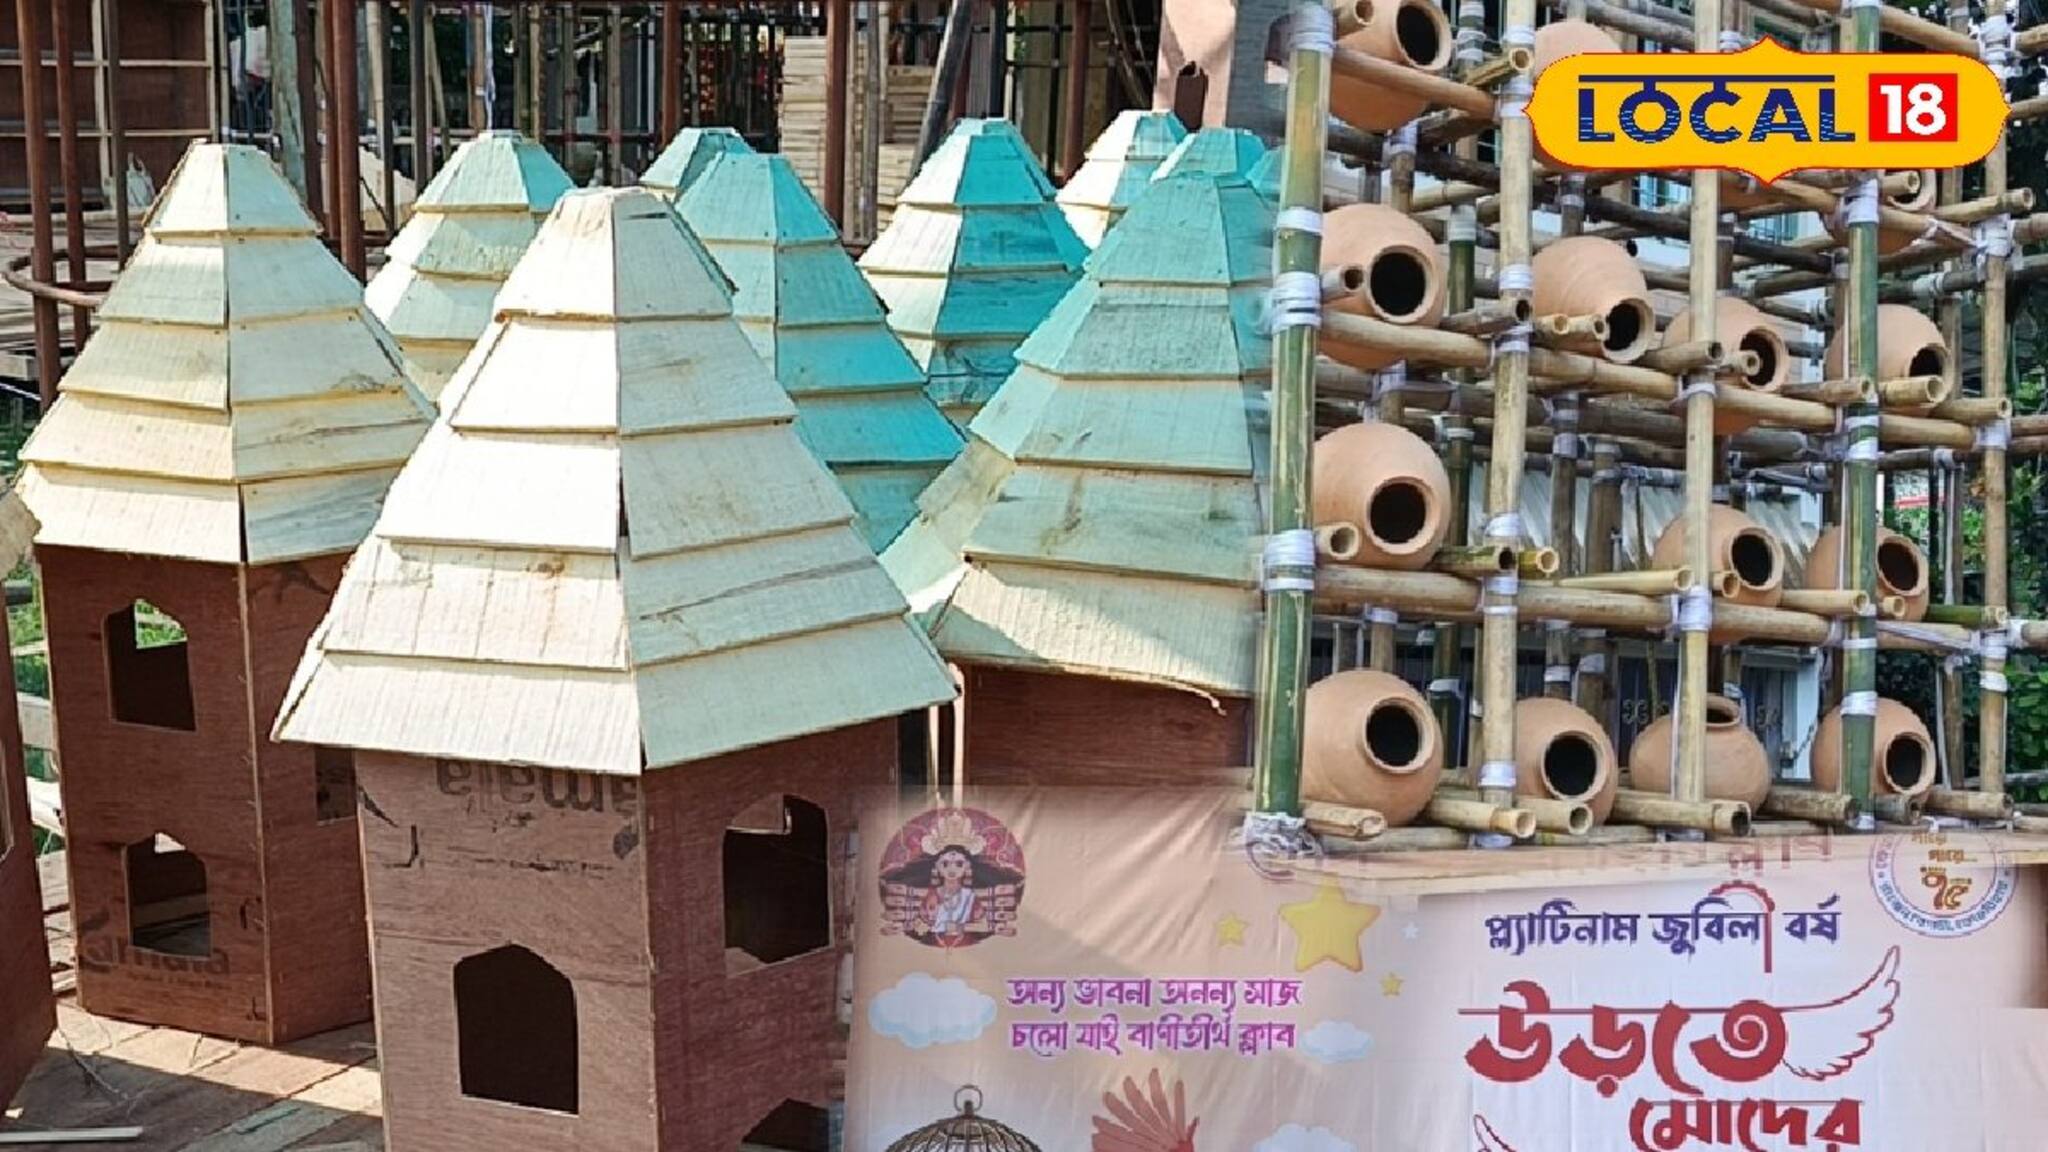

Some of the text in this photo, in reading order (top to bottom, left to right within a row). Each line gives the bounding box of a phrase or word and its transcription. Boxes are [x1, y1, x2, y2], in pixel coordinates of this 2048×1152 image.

[1485, 900, 1640, 955] প্ল্যাটিনাম
[1648, 880, 1775, 973] জুবিলী
[1783, 894, 1842, 941] বর্ষ
[1008, 978, 1303, 1013] অন্য ভাবনা অনন্য সাজ
[1012, 1012, 1295, 1056] চলো যাই বাণীতীর্থ ক্লাব
[1459, 980, 1787, 1097] উড়তে
[1629, 1097, 1863, 1152] মোদের
